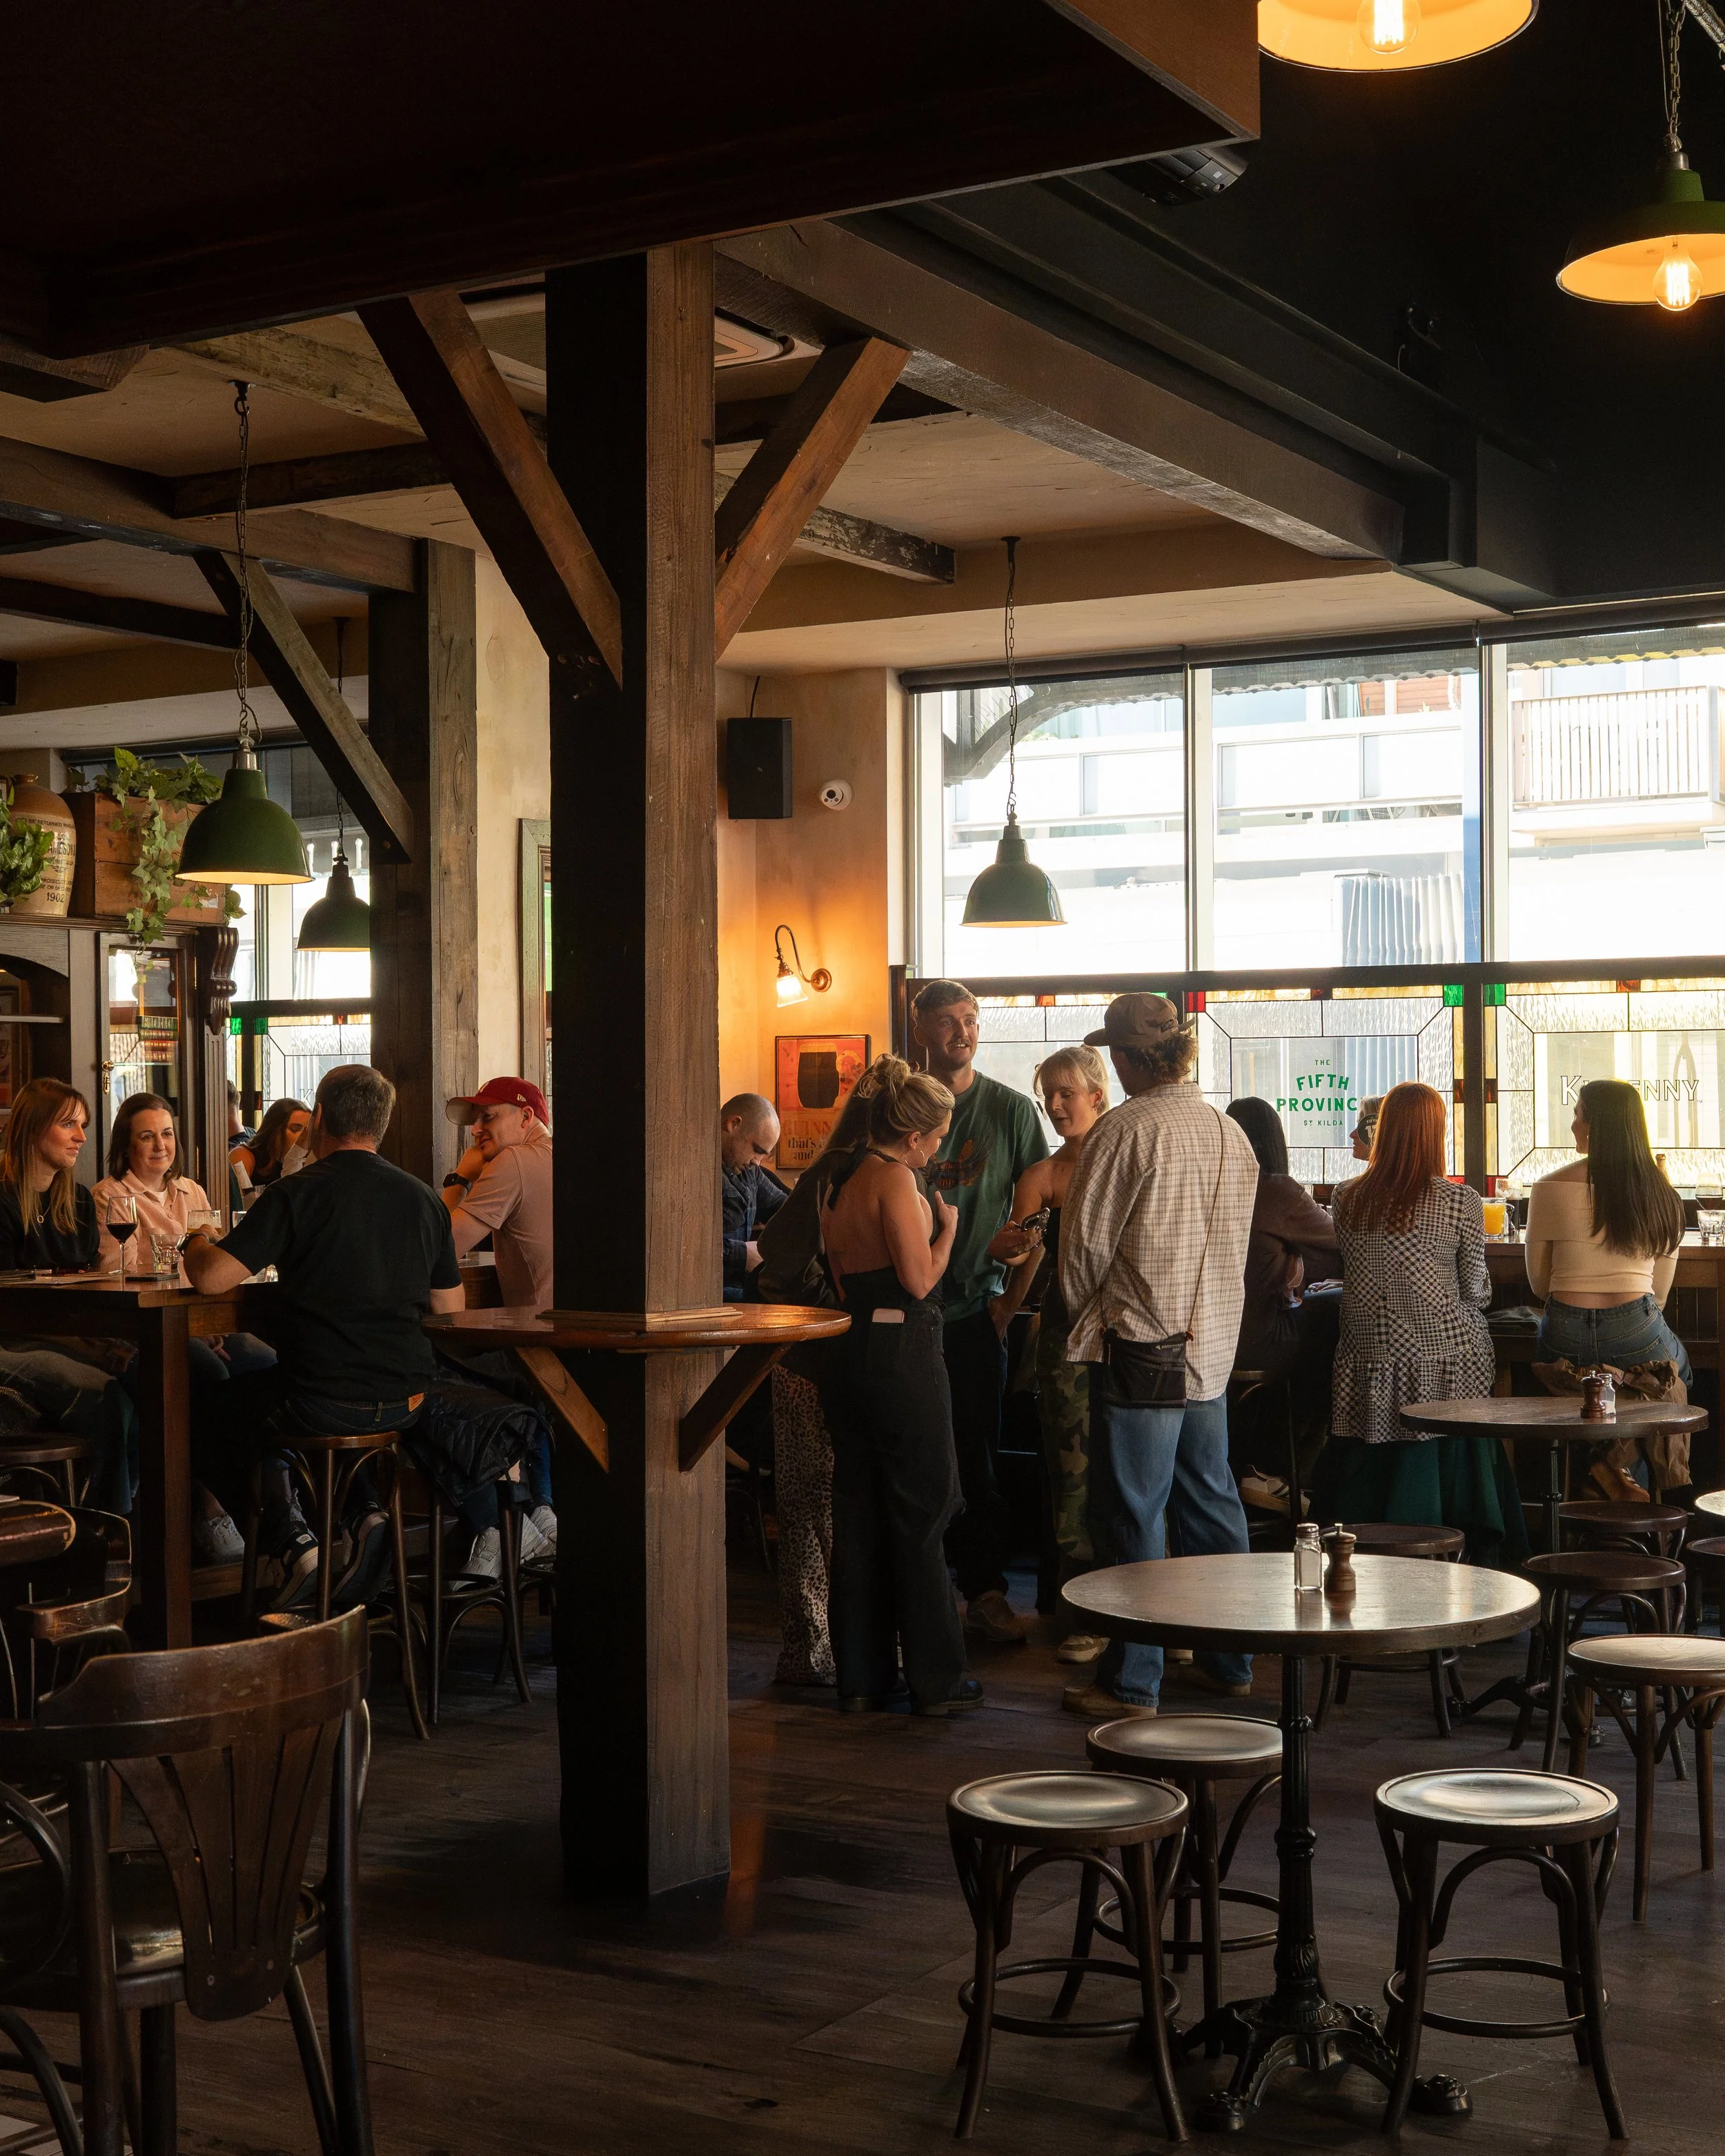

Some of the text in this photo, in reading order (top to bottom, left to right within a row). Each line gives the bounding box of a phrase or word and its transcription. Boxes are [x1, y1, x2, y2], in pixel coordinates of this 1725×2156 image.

[46, 892, 65, 903] 1902
[1296, 1074, 1350, 1091] FIFTH
[1276, 1097, 1362, 1111] PROVINC
